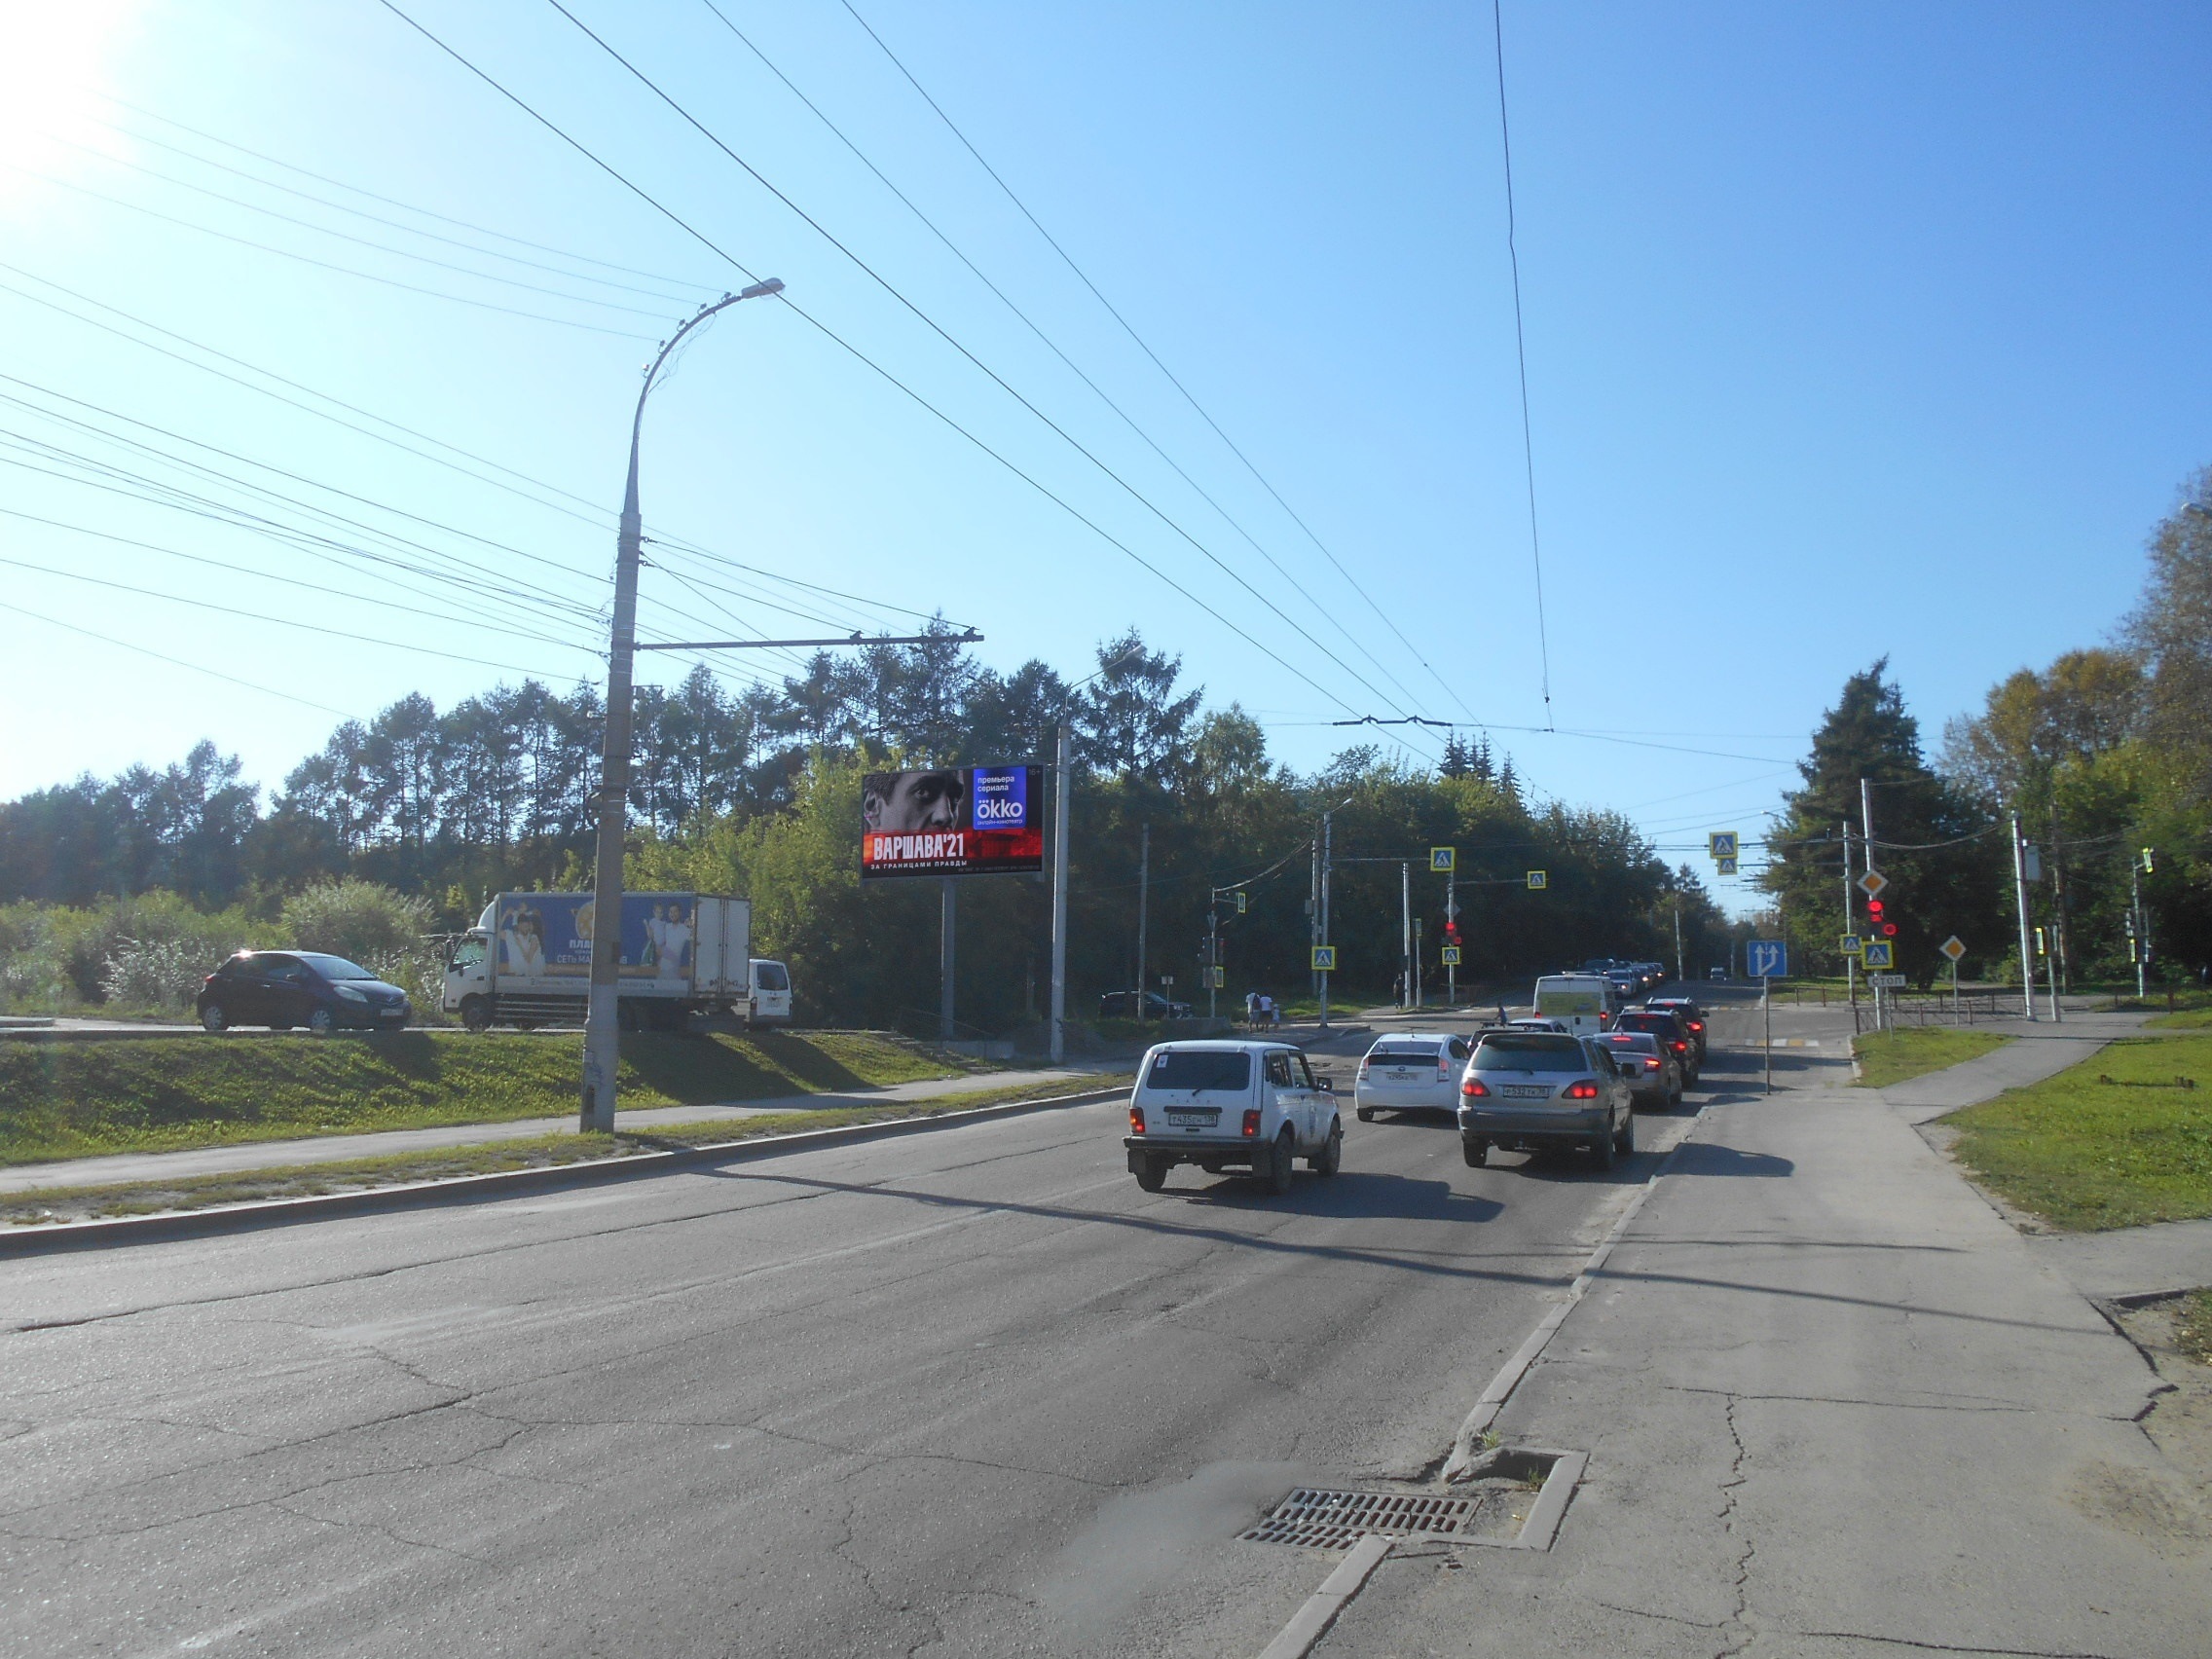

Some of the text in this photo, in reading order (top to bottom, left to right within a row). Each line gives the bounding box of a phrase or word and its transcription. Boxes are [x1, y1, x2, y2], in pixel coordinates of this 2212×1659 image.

[977, 776, 1014, 785] премьера
[977, 785, 1009, 793] сериала
[1872, 977, 1902, 985] СТОП
